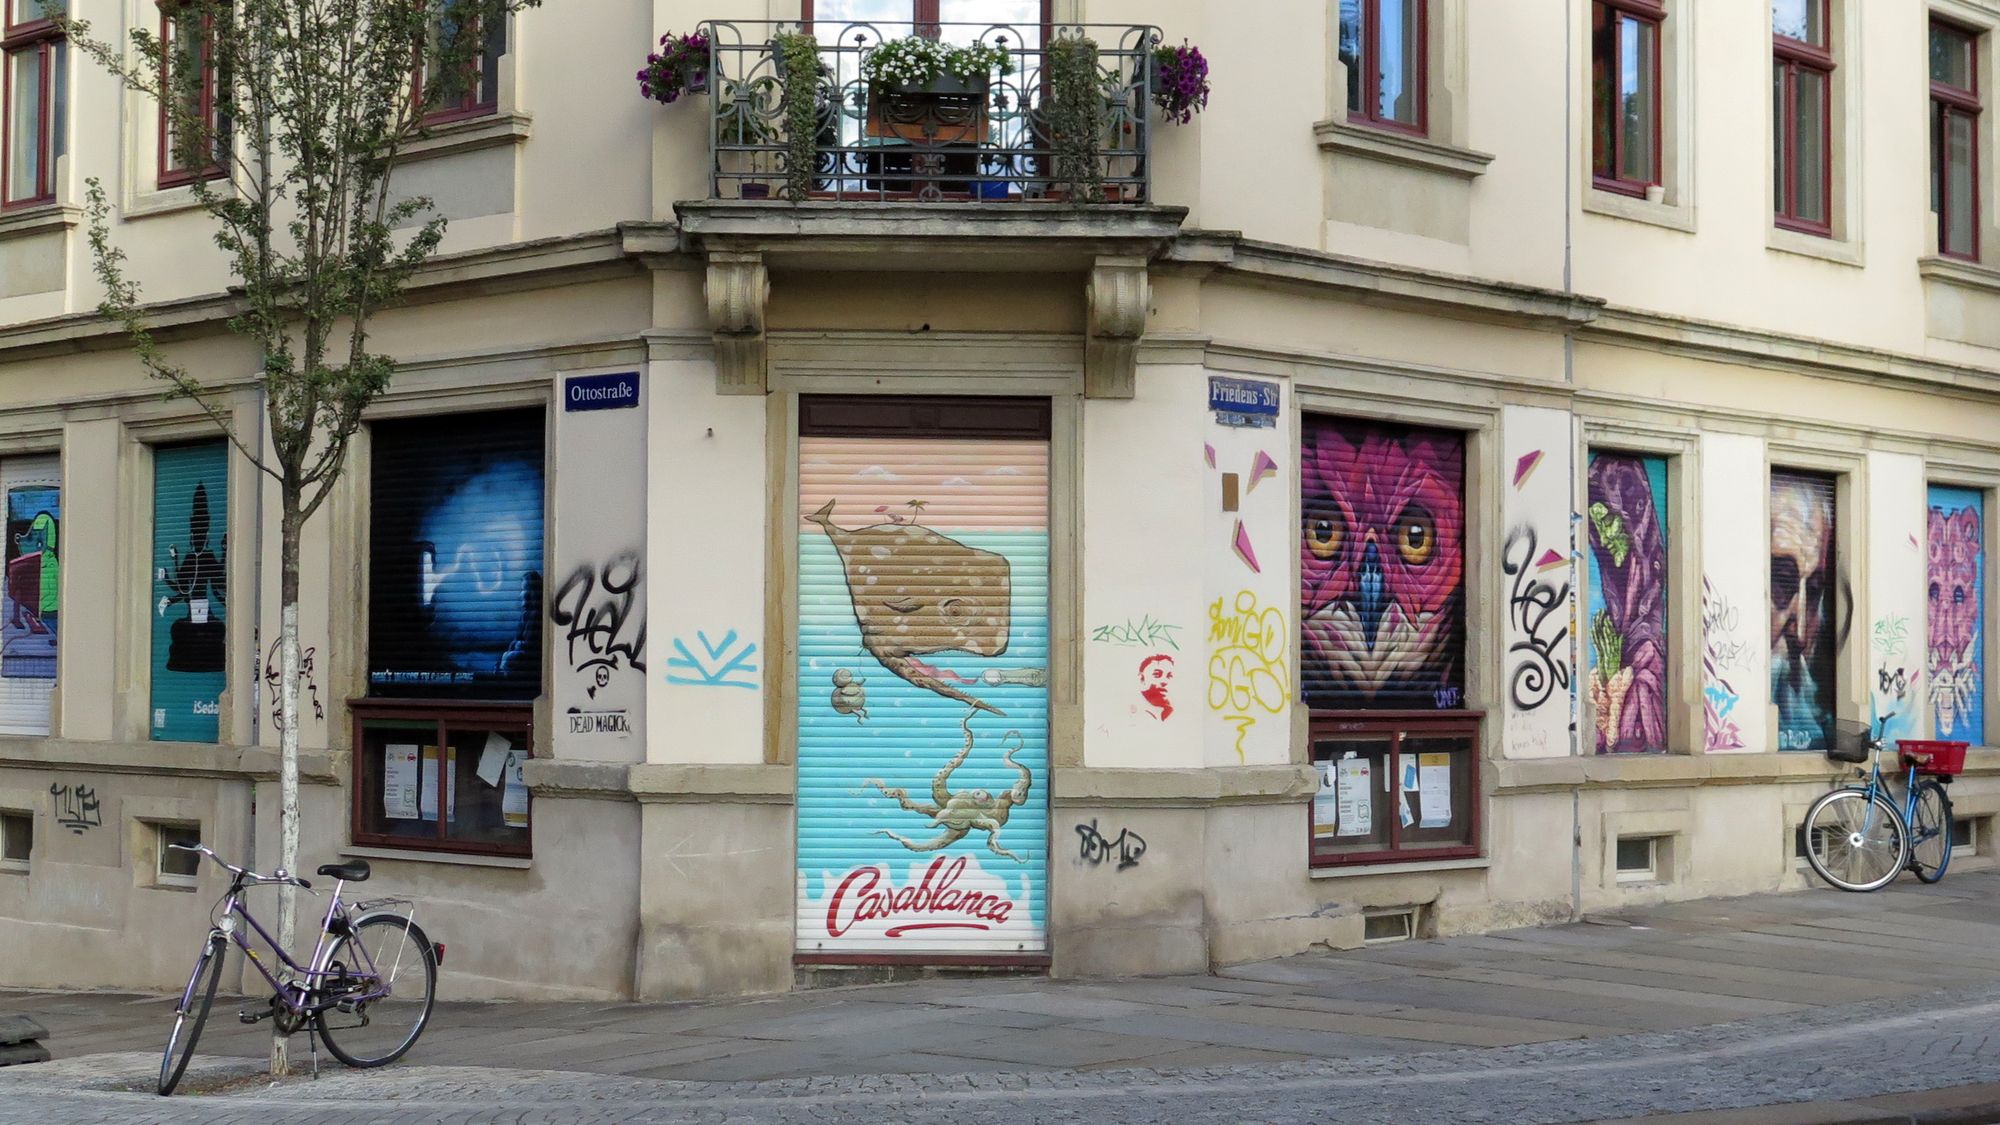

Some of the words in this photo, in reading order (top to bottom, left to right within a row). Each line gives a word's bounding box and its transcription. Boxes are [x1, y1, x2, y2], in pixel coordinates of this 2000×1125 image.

[571, 381, 633, 401] Ottostraße
[569, 716, 594, 733] DEAD
[826, 855, 1014, 938] Casablanca
